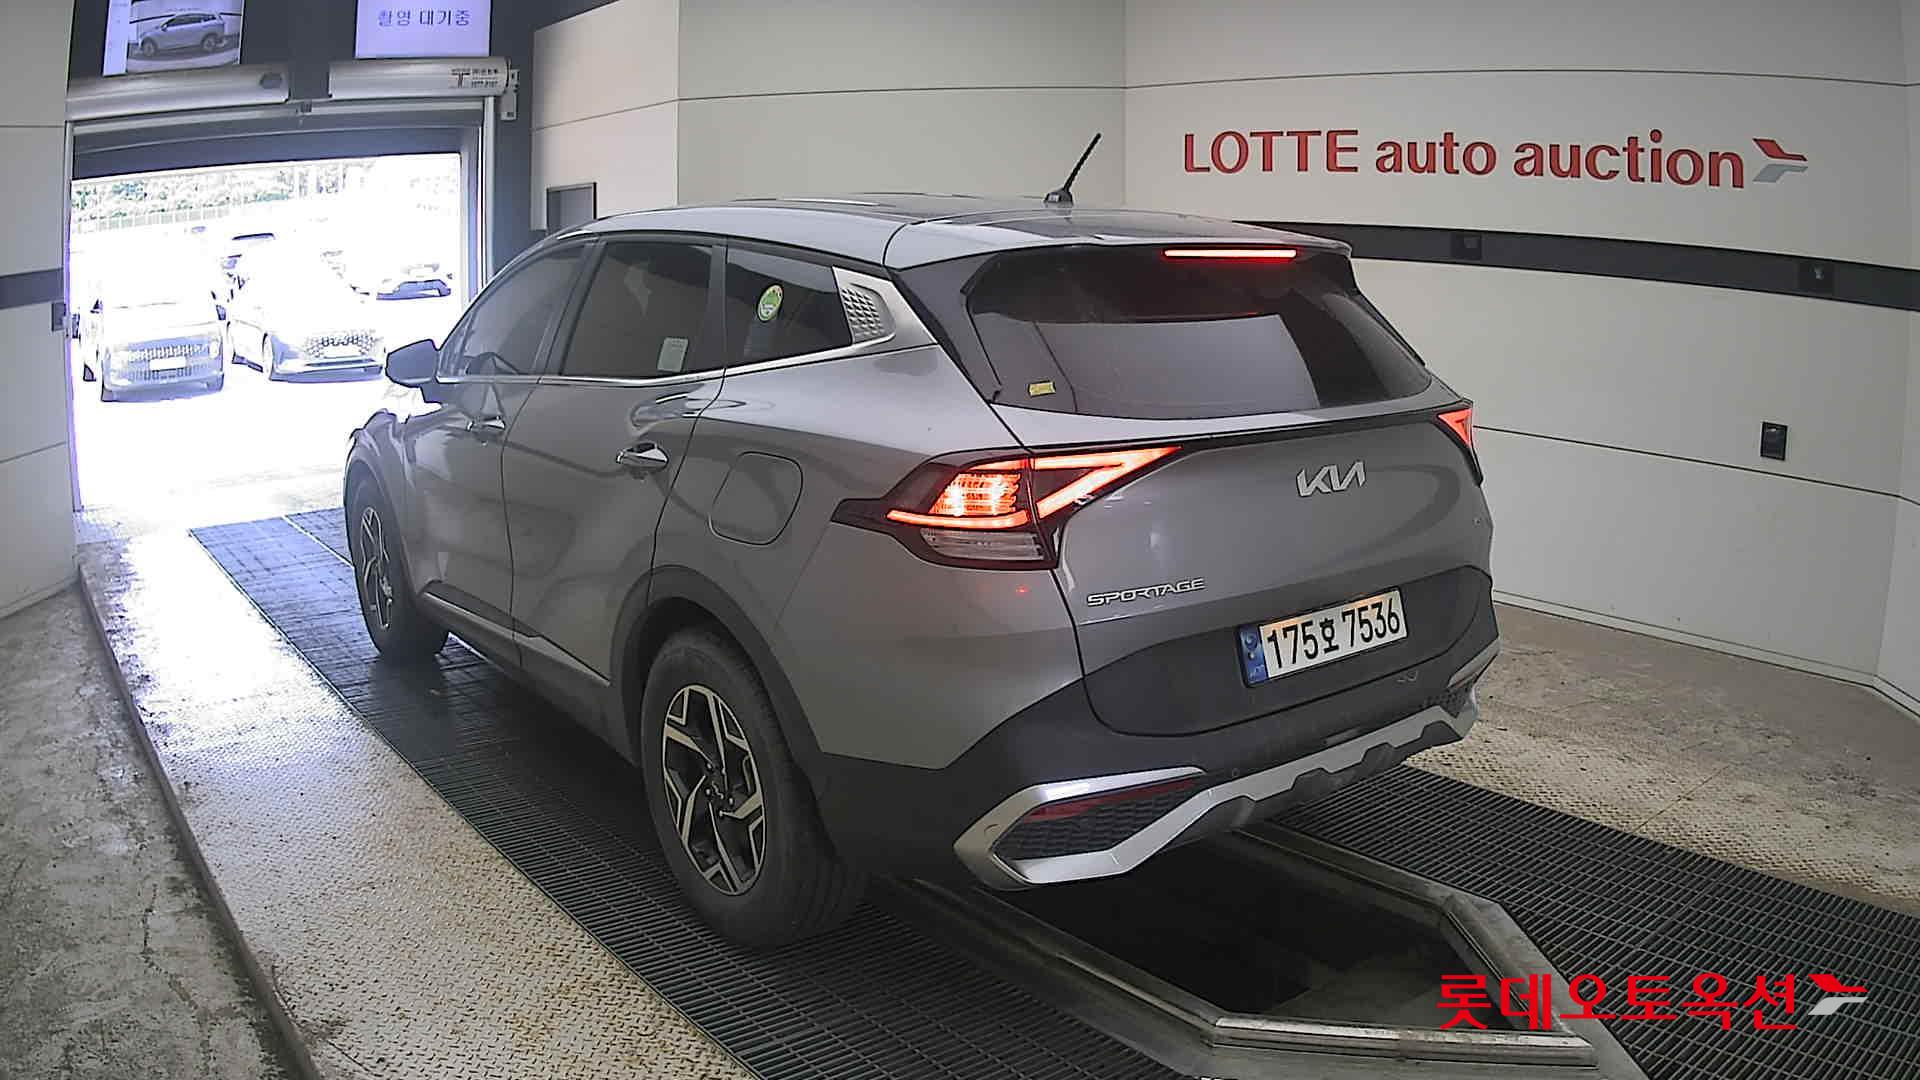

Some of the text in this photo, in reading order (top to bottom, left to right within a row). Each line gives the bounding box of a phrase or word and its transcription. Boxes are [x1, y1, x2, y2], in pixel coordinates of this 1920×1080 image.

[419, 9, 471, 27] 대기중
[1184, 128, 1745, 189] LOTTE auto auction
[1296, 460, 1367, 498] KIA
[1087, 577, 1206, 607] SPORTAGE
[1267, 597, 1401, 669] 175호 7536
